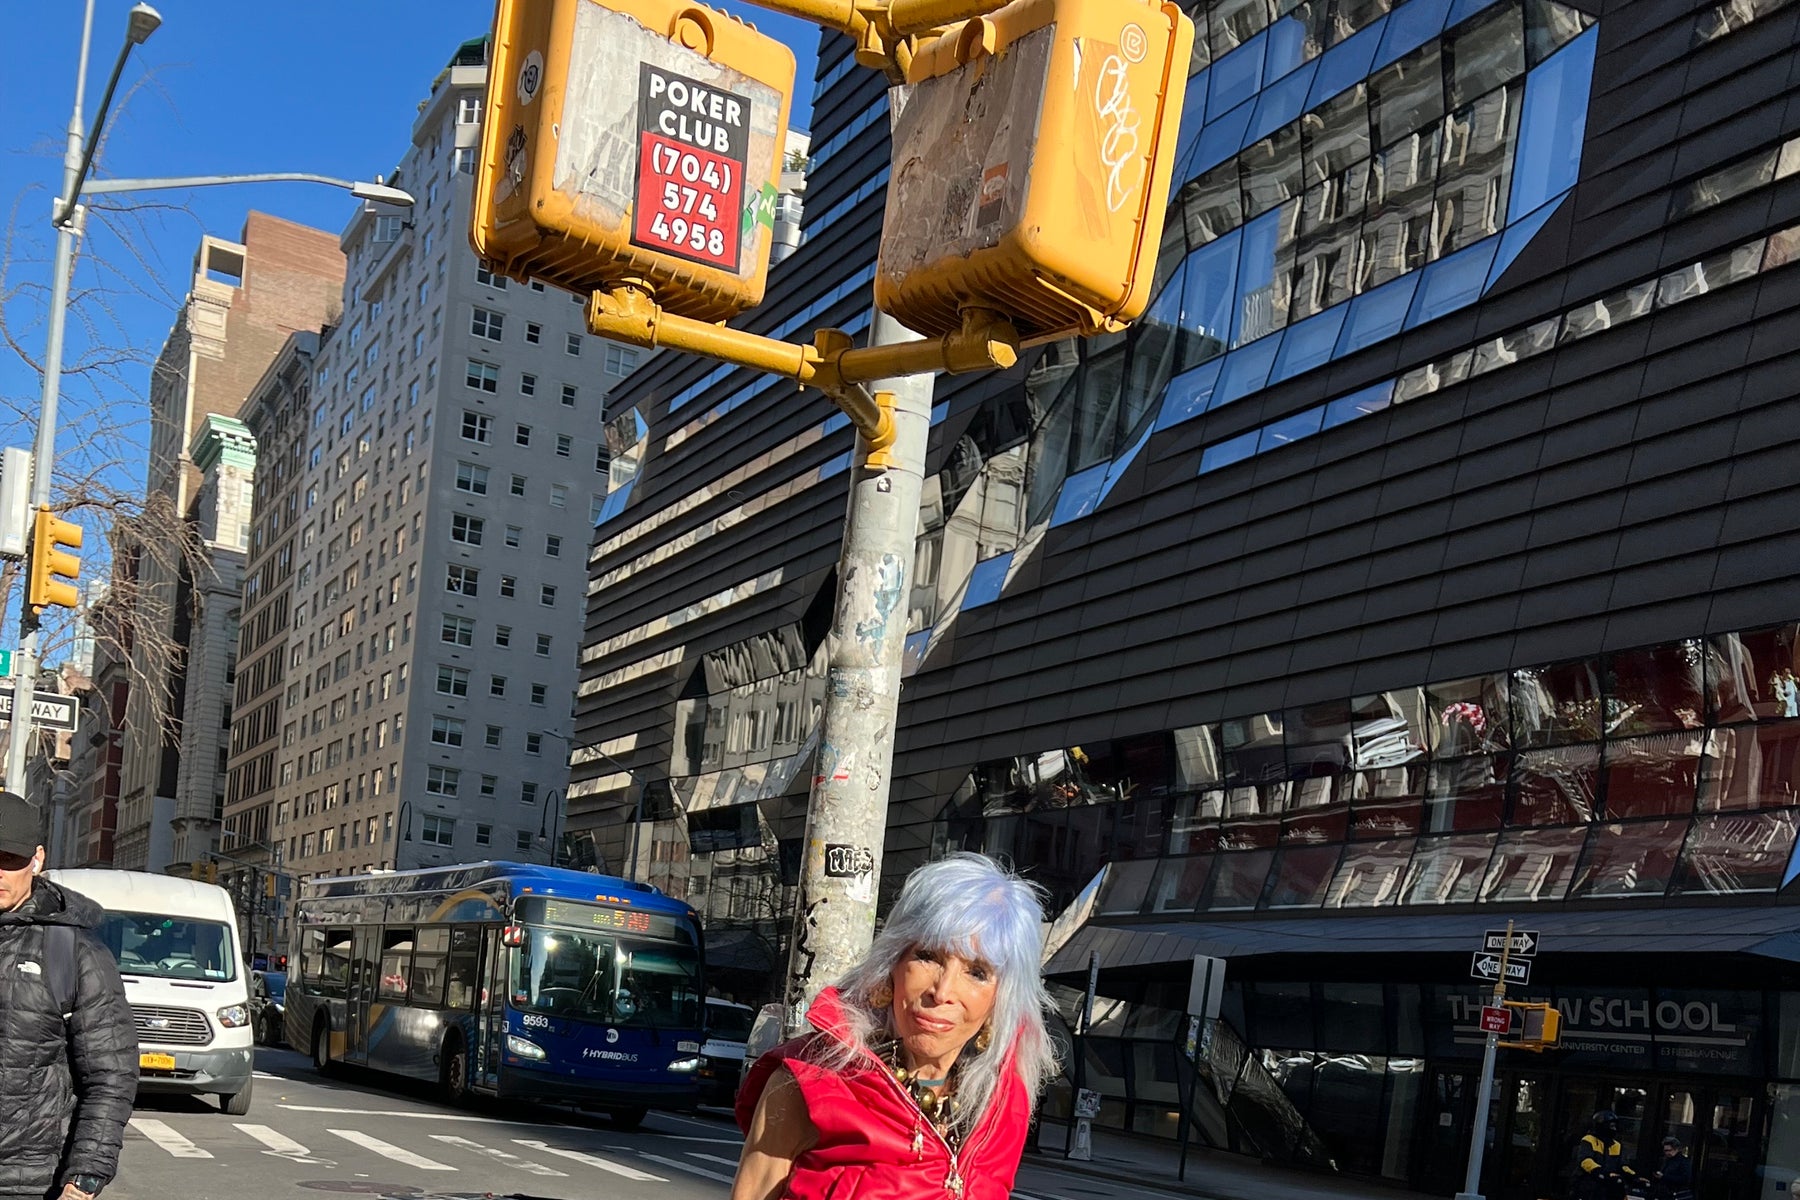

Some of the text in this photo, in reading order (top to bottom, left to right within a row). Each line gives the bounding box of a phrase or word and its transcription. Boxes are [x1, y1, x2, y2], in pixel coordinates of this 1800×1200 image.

[650, 73, 742, 127] POKER
[659, 109, 730, 153] CLUB
[652, 143, 732, 194] (704)
[663, 181, 718, 223] 574
[650, 213, 725, 257] 4958
[32, 703, 62, 718] WAY
[1491, 938, 1530, 947] ONE WAY
[1481, 961, 1522, 976] ONE WAY
[523, 1014, 549, 1028] 9593
[1447, 995, 1493, 1020] TH
[1589, 997, 1737, 1032] SCHOOL
[1486, 1016, 1505, 1024] WRONG
[1559, 1042, 1645, 1055] UNIVERSITY CENTER
